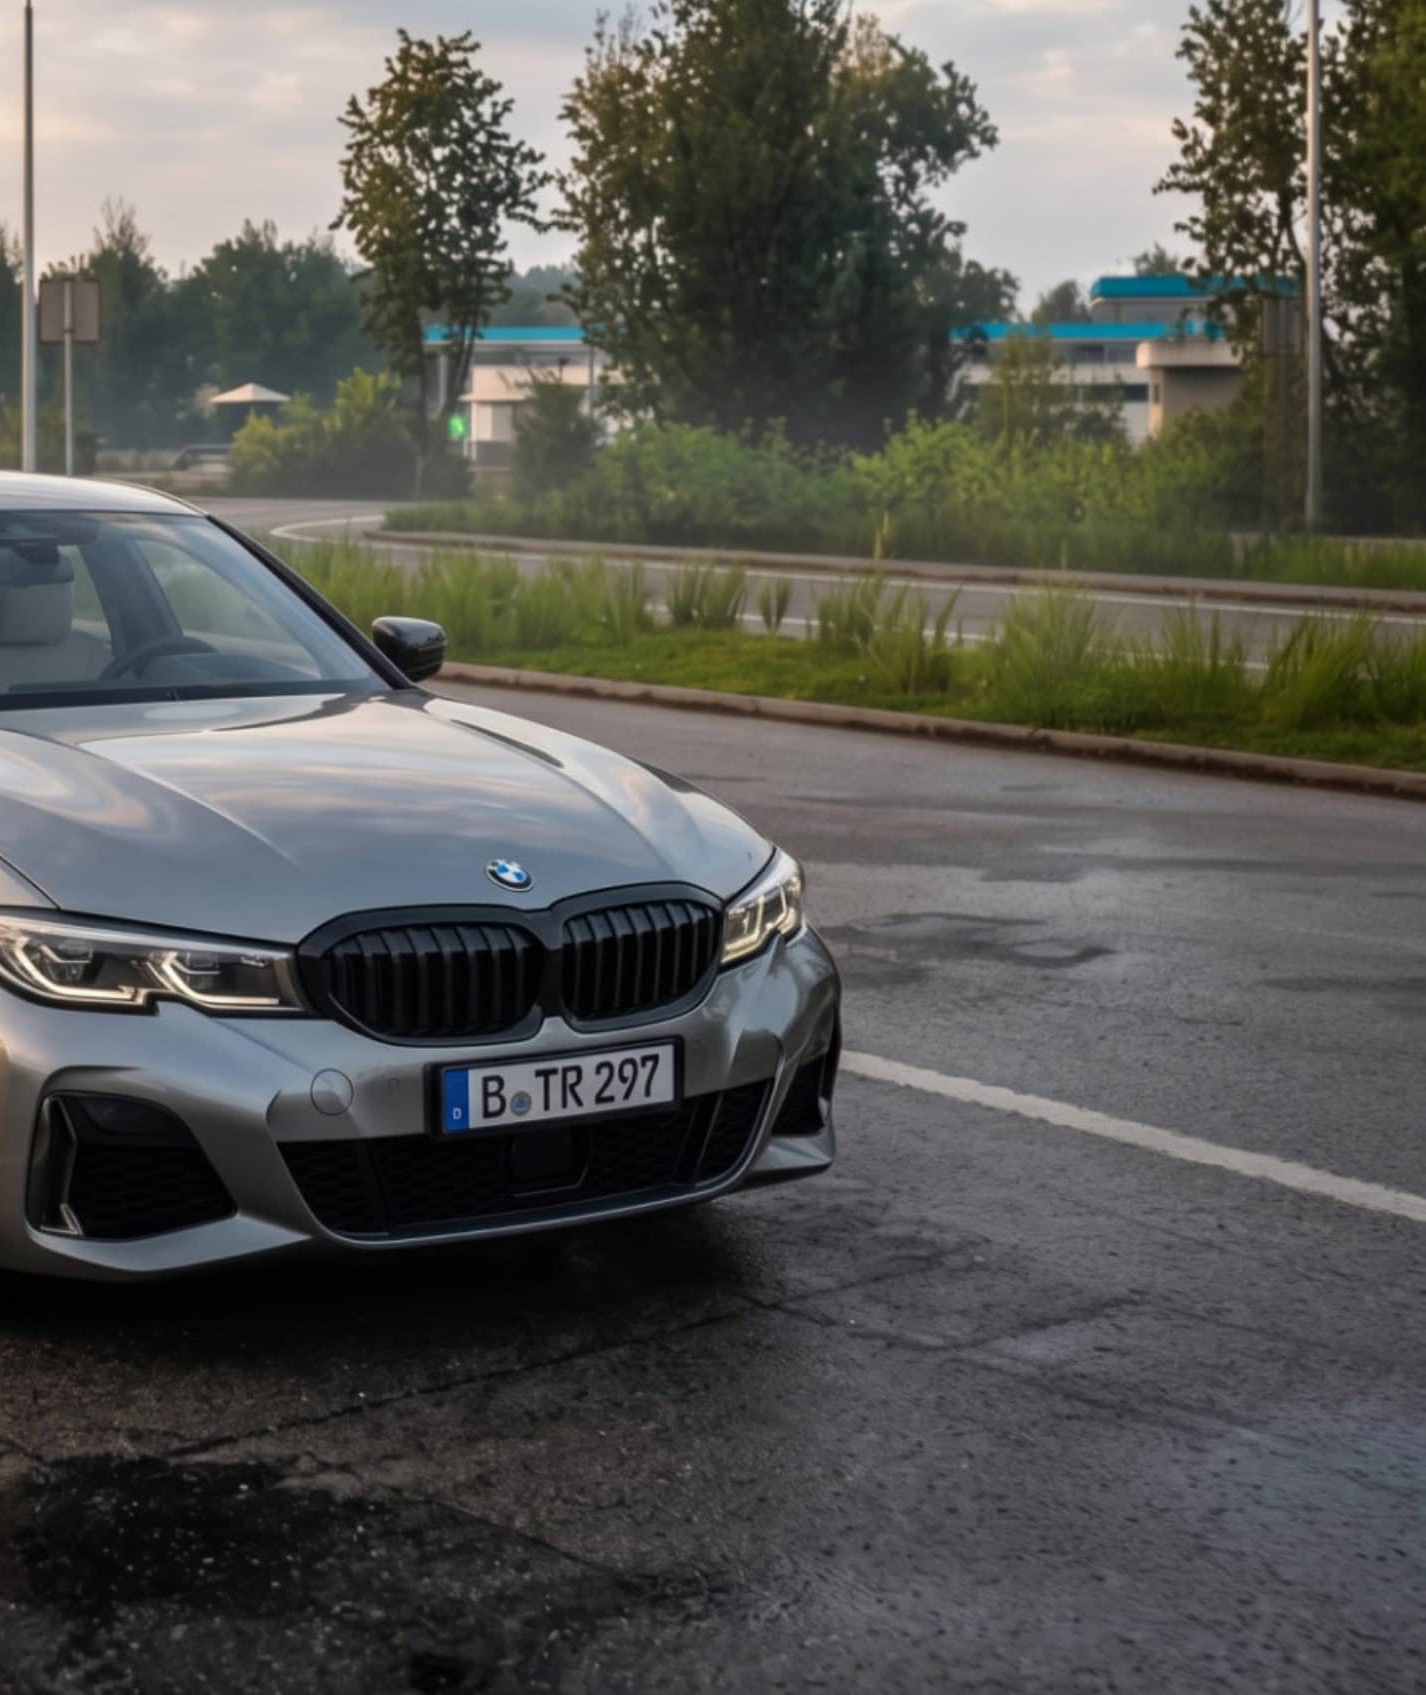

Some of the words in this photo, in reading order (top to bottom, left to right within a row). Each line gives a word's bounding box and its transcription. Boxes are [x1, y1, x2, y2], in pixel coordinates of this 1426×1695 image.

[482, 1075, 506, 1118] B
[535, 1066, 583, 1111] TR
[595, 1054, 659, 1104] 297
[453, 1108, 462, 1119] D
